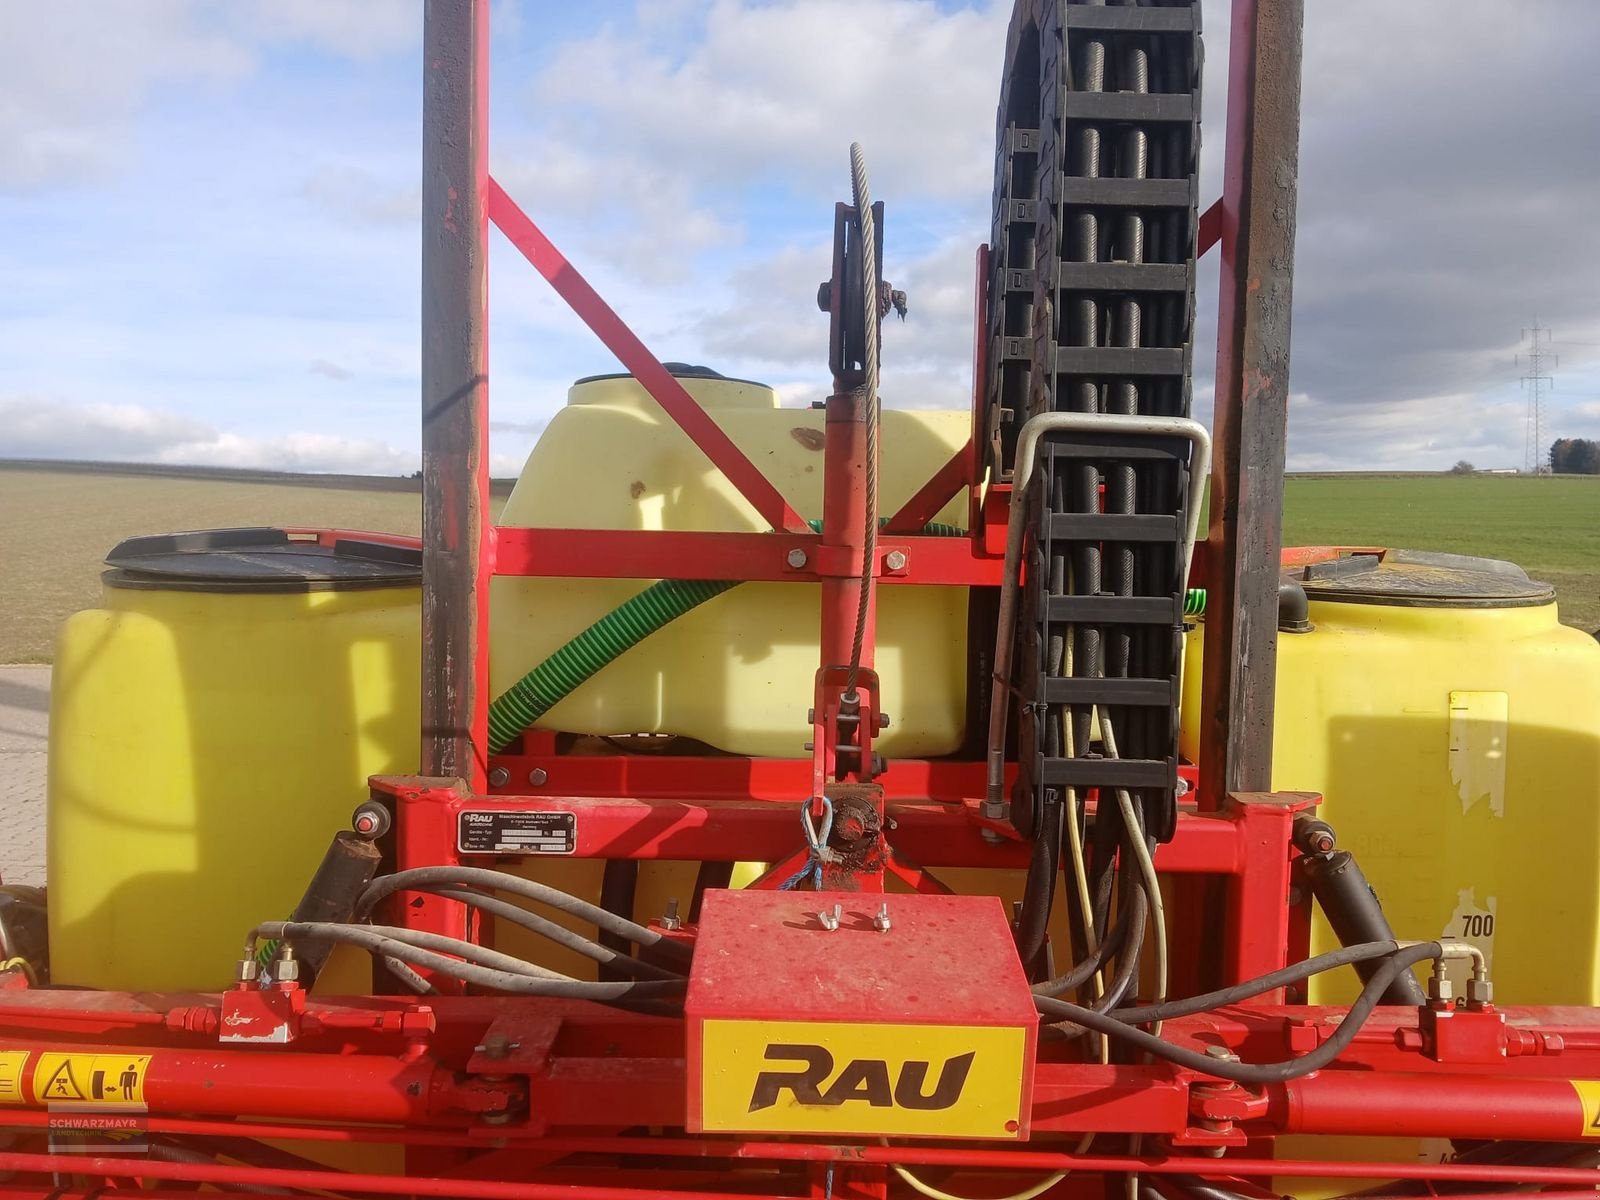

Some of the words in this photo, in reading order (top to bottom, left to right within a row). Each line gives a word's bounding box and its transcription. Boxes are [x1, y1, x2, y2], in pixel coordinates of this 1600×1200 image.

[470, 814, 493, 822] RAU
[1462, 914, 1494, 937] 700
[748, 1043, 976, 1113] RAU
